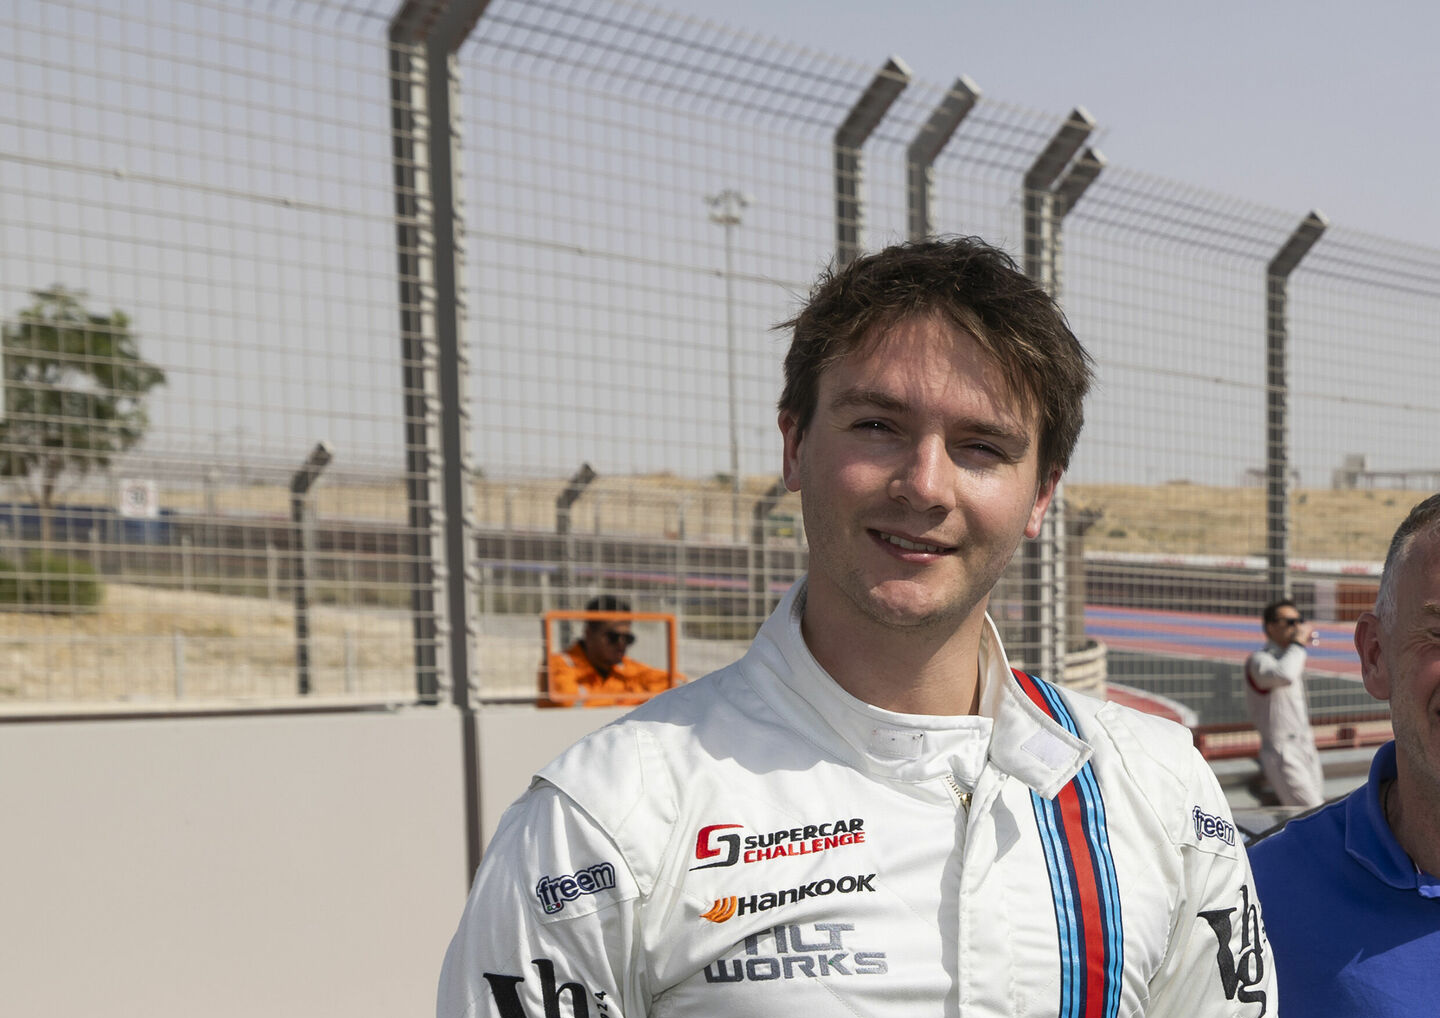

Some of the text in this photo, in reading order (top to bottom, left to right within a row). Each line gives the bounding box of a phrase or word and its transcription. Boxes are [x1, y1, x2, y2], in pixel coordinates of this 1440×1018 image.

[744, 818, 865, 850] SUPERCAR
[1194, 808, 1235, 846] freem
[743, 831, 866, 863] CHALLENGE
[538, 864, 614, 908] freem
[704, 951, 889, 984] WORKS
